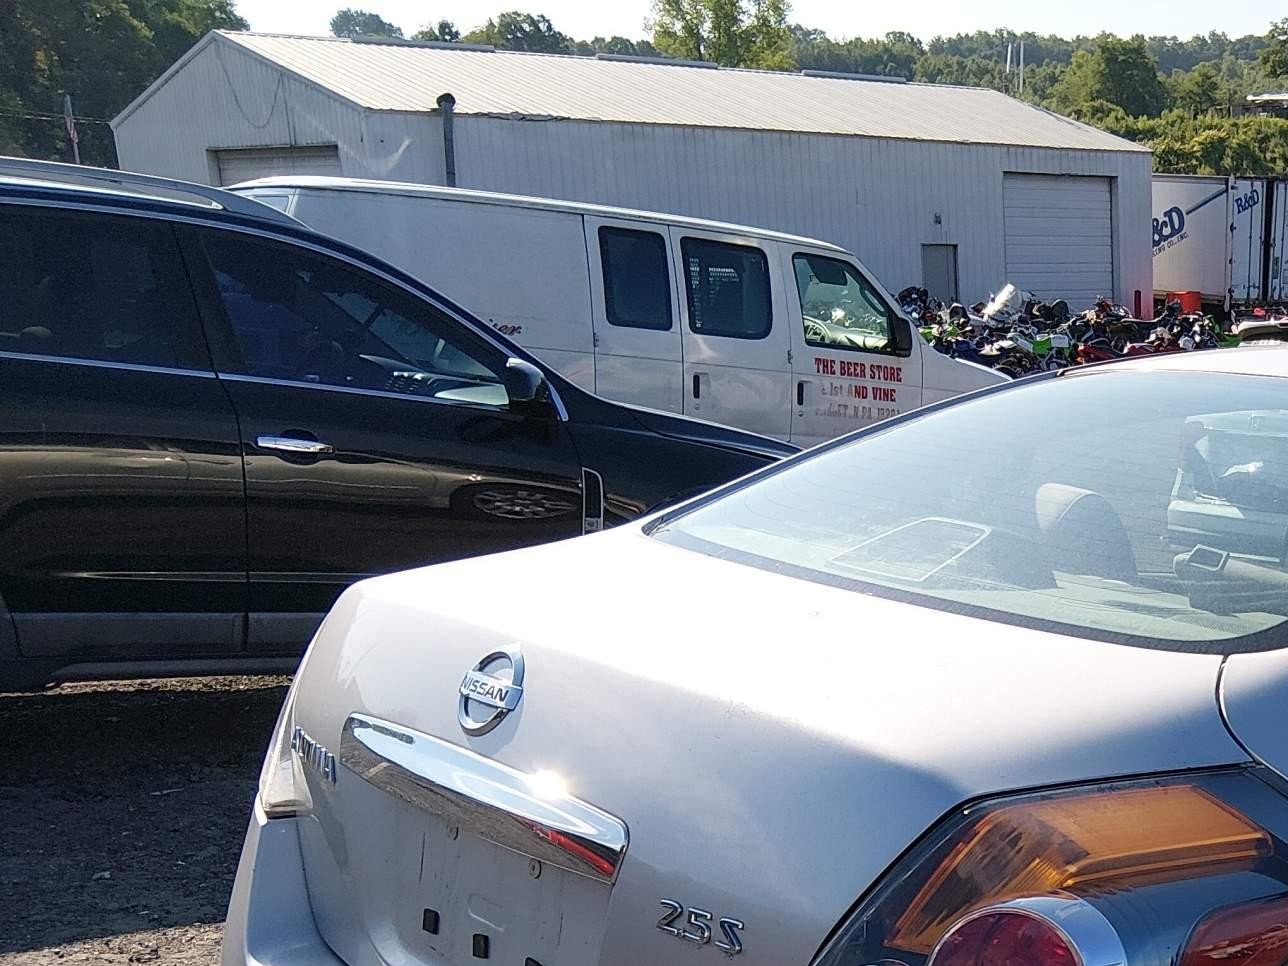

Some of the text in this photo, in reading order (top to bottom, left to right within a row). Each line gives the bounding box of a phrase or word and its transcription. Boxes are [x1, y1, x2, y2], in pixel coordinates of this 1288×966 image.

[1234, 189, 1260, 214] R&D
[815, 357, 902, 383] THE BEER STORE
[872, 386, 897, 402] VINE
[460, 671, 510, 702] NISSAN
